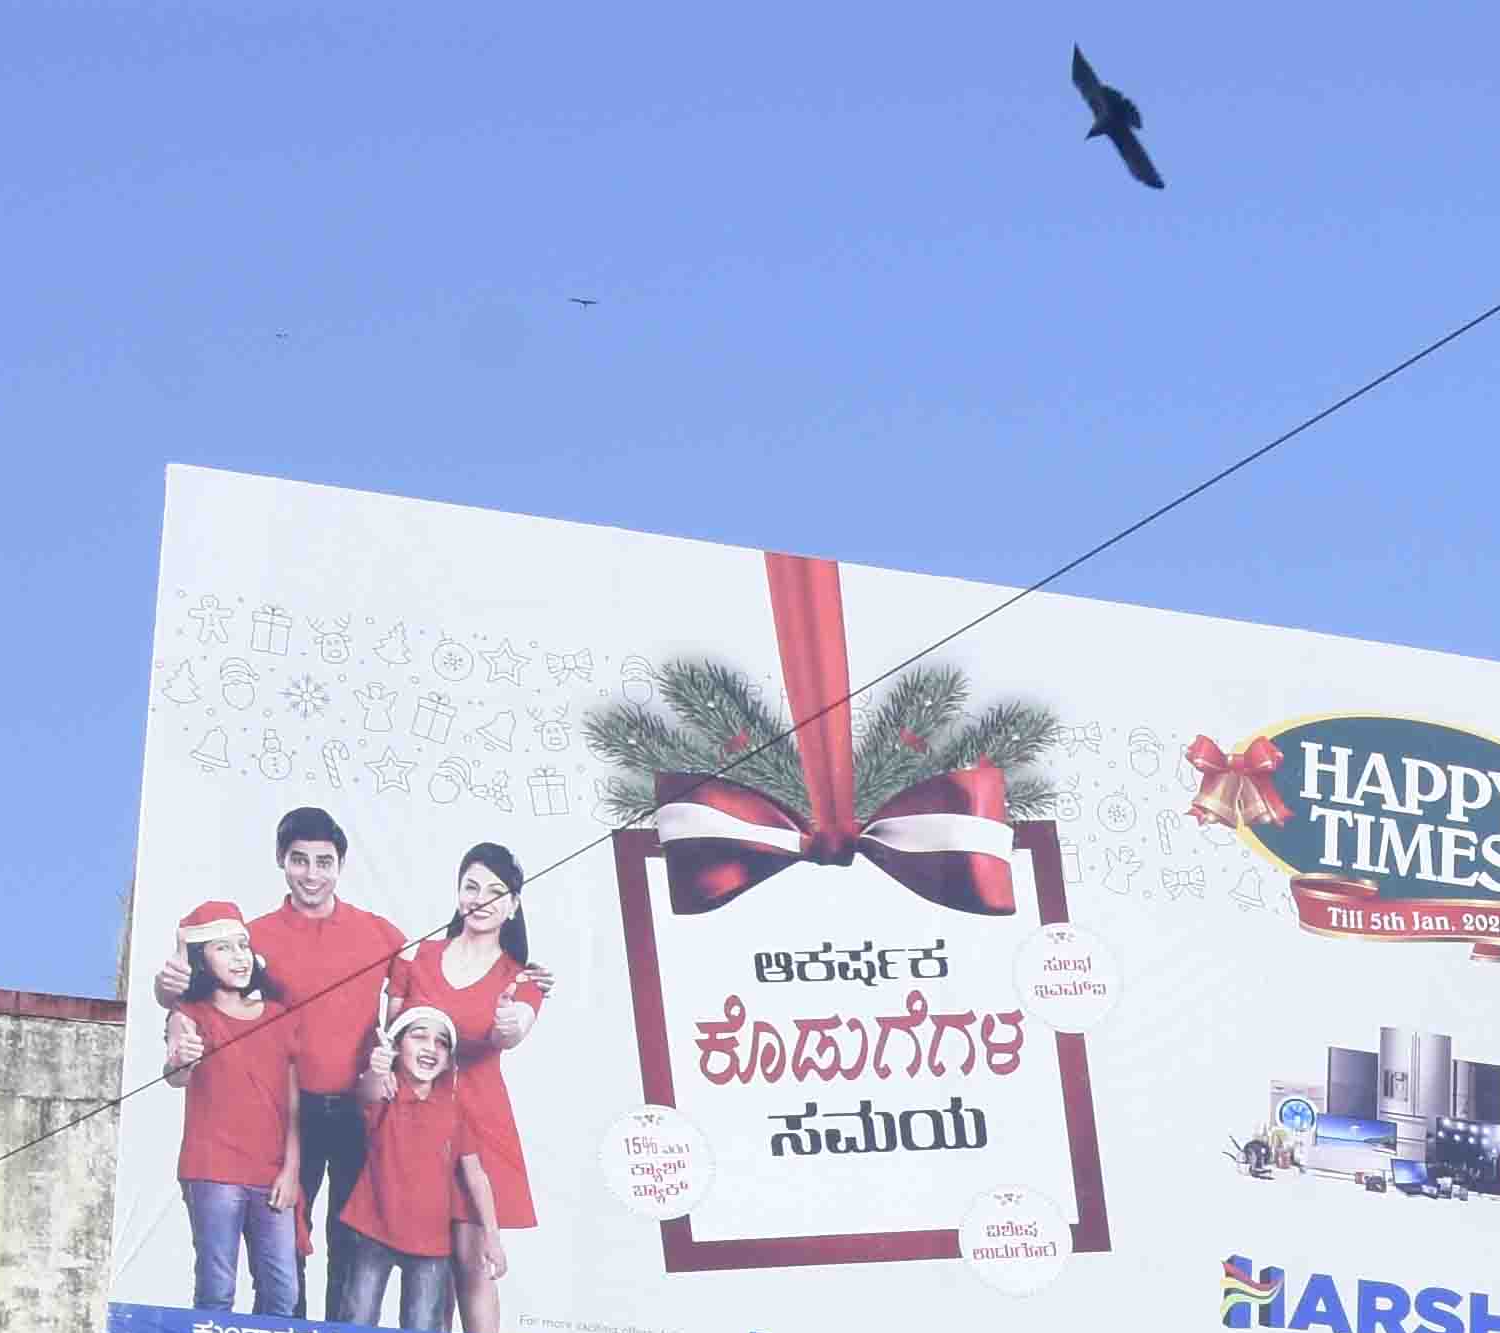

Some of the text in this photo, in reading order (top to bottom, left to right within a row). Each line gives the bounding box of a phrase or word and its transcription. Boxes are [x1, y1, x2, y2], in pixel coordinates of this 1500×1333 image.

[1327, 906, 1364, 930] Till
[1370, 910, 1406, 932] 5th
[754, 938, 950, 987] ಆಕರ್ಷಕ
[694, 989, 1025, 1086] ಕೊಡುಗೆಗಳ
[624, 1136, 658, 1155] 15%
[767, 1096, 989, 1158] ಸಮಯ
